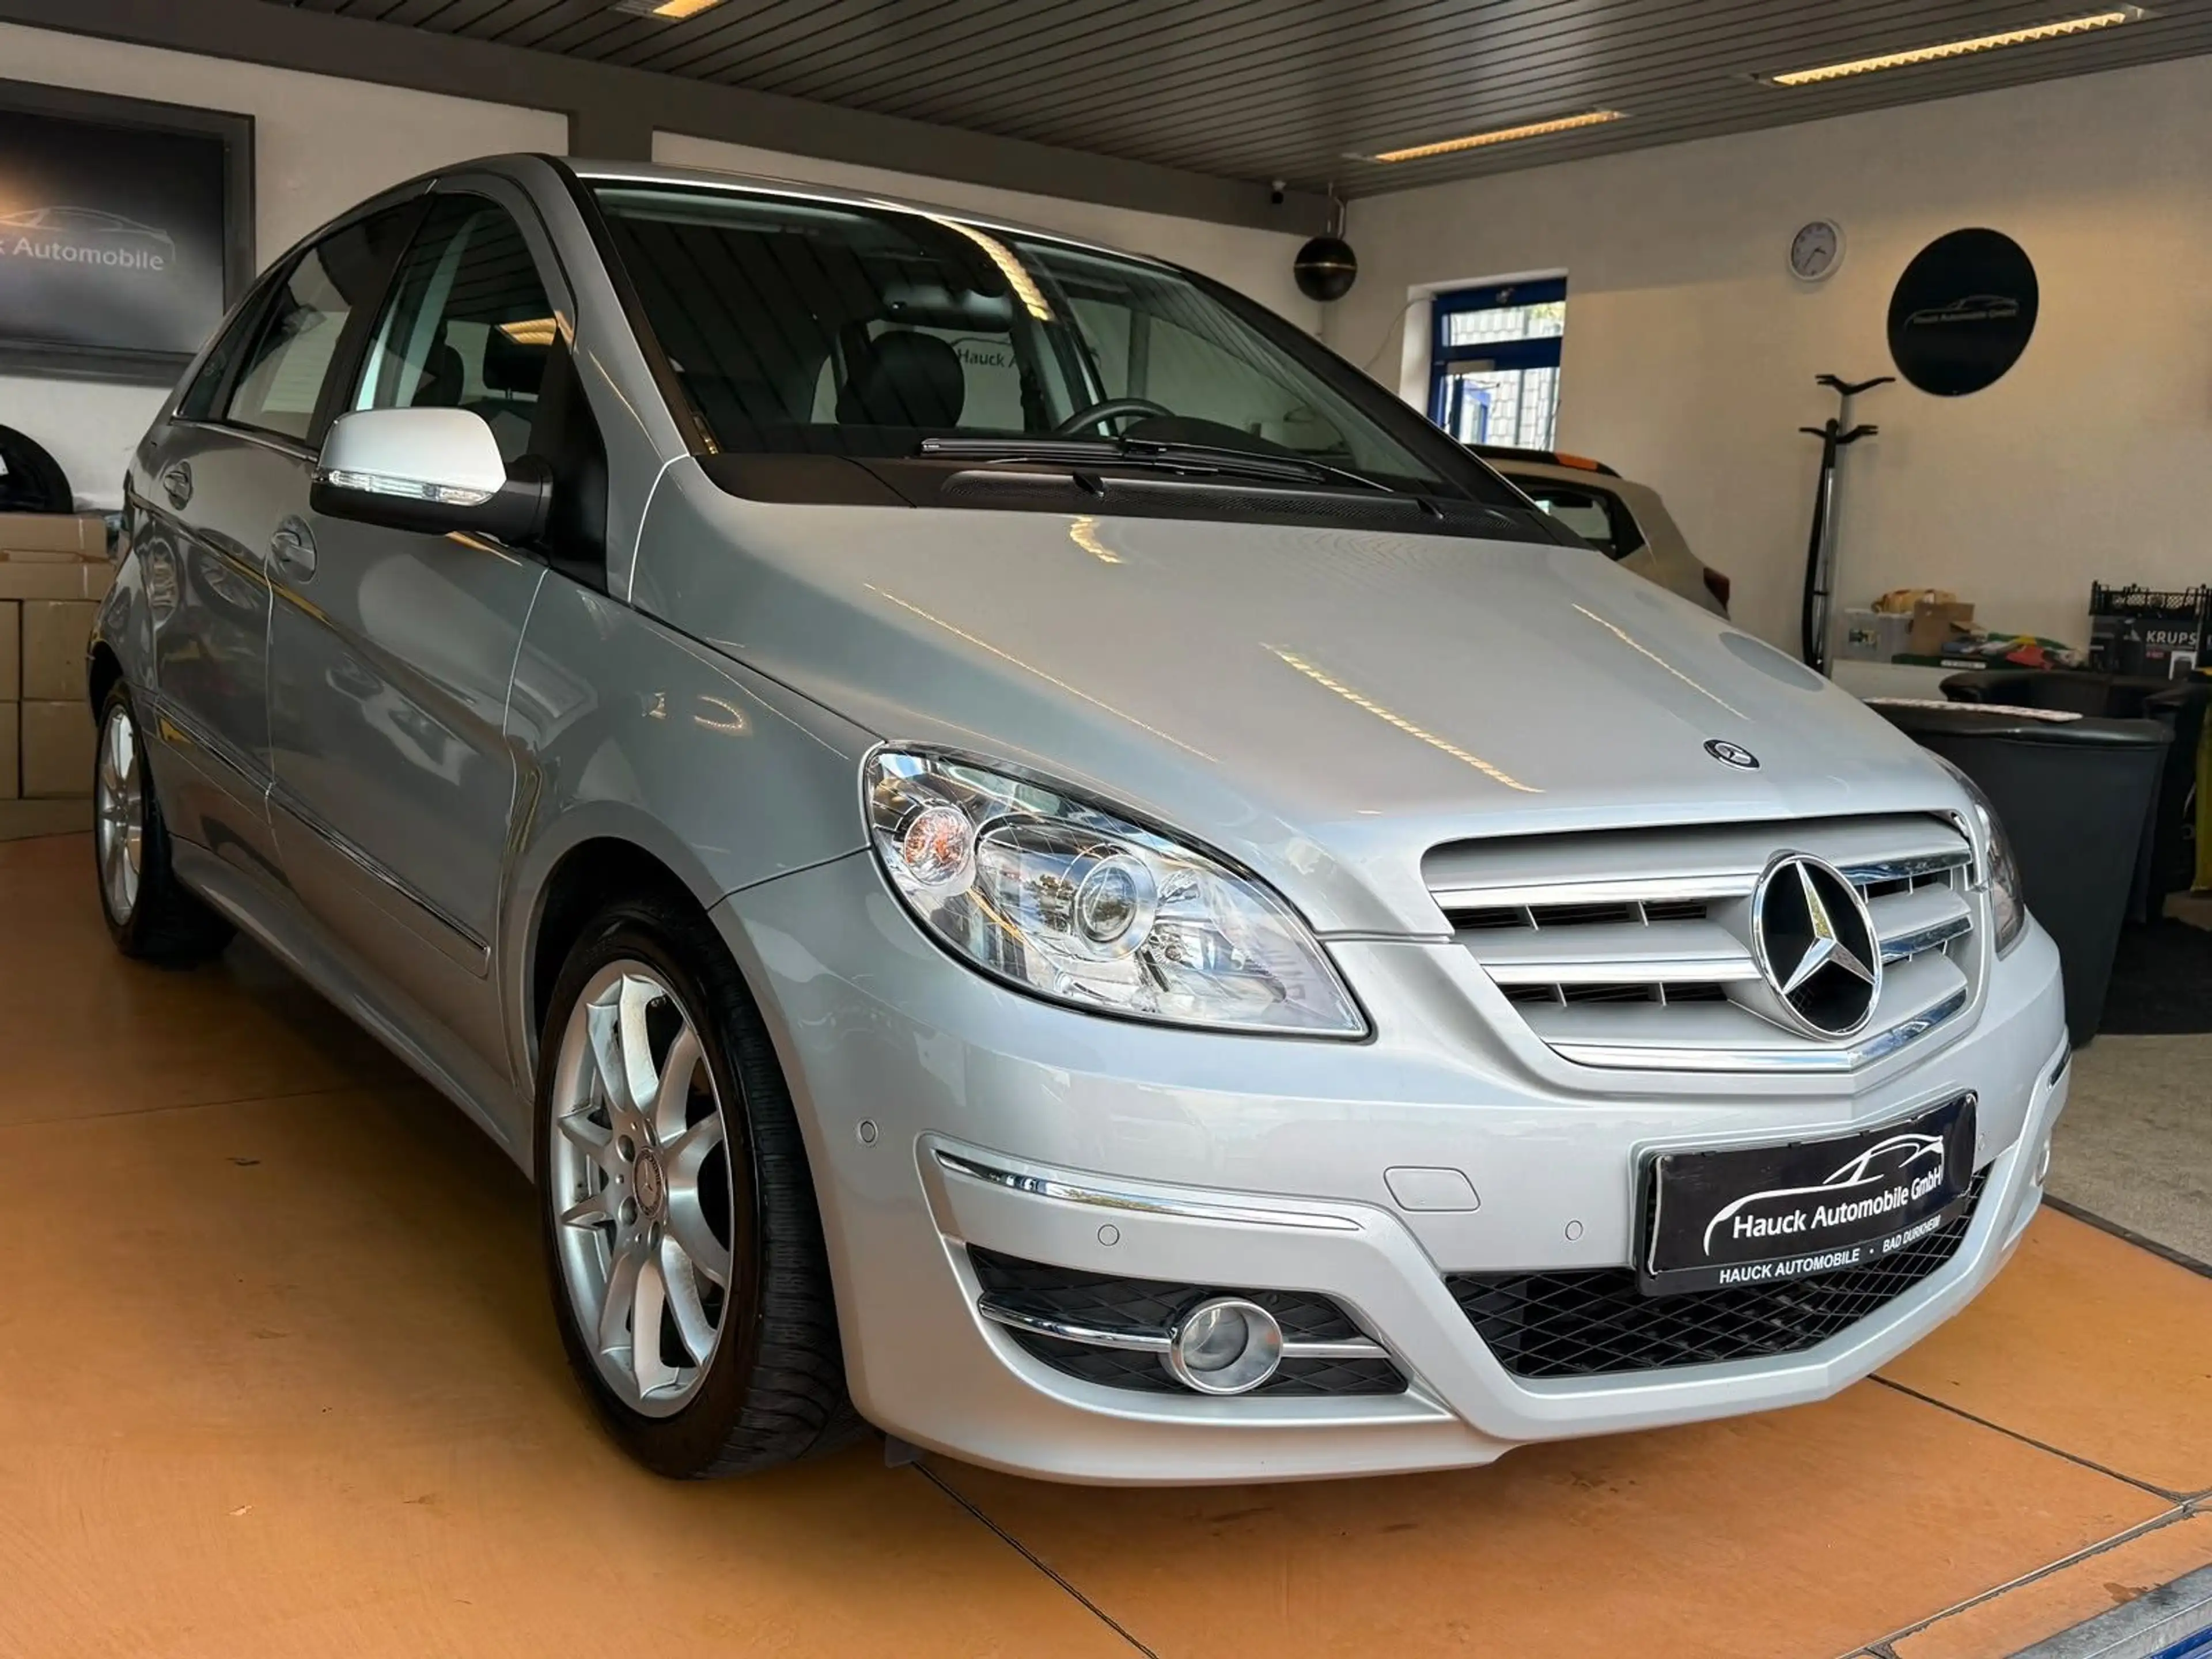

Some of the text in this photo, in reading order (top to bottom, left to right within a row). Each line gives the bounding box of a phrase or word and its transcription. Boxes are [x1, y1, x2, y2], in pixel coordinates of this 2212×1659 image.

[13, 237, 165, 271] Automobile
[957, 348, 1005, 368] Hauck
[2146, 630, 2198, 645] KRUPS
[1733, 1165, 1942, 1238] Hauck Automobile GmbH
[1719, 1264, 1772, 1284] HAUCK
[1774, 1248, 1860, 1277] AUTOMOBILE
[1883, 1234, 1902, 1253] BAD
